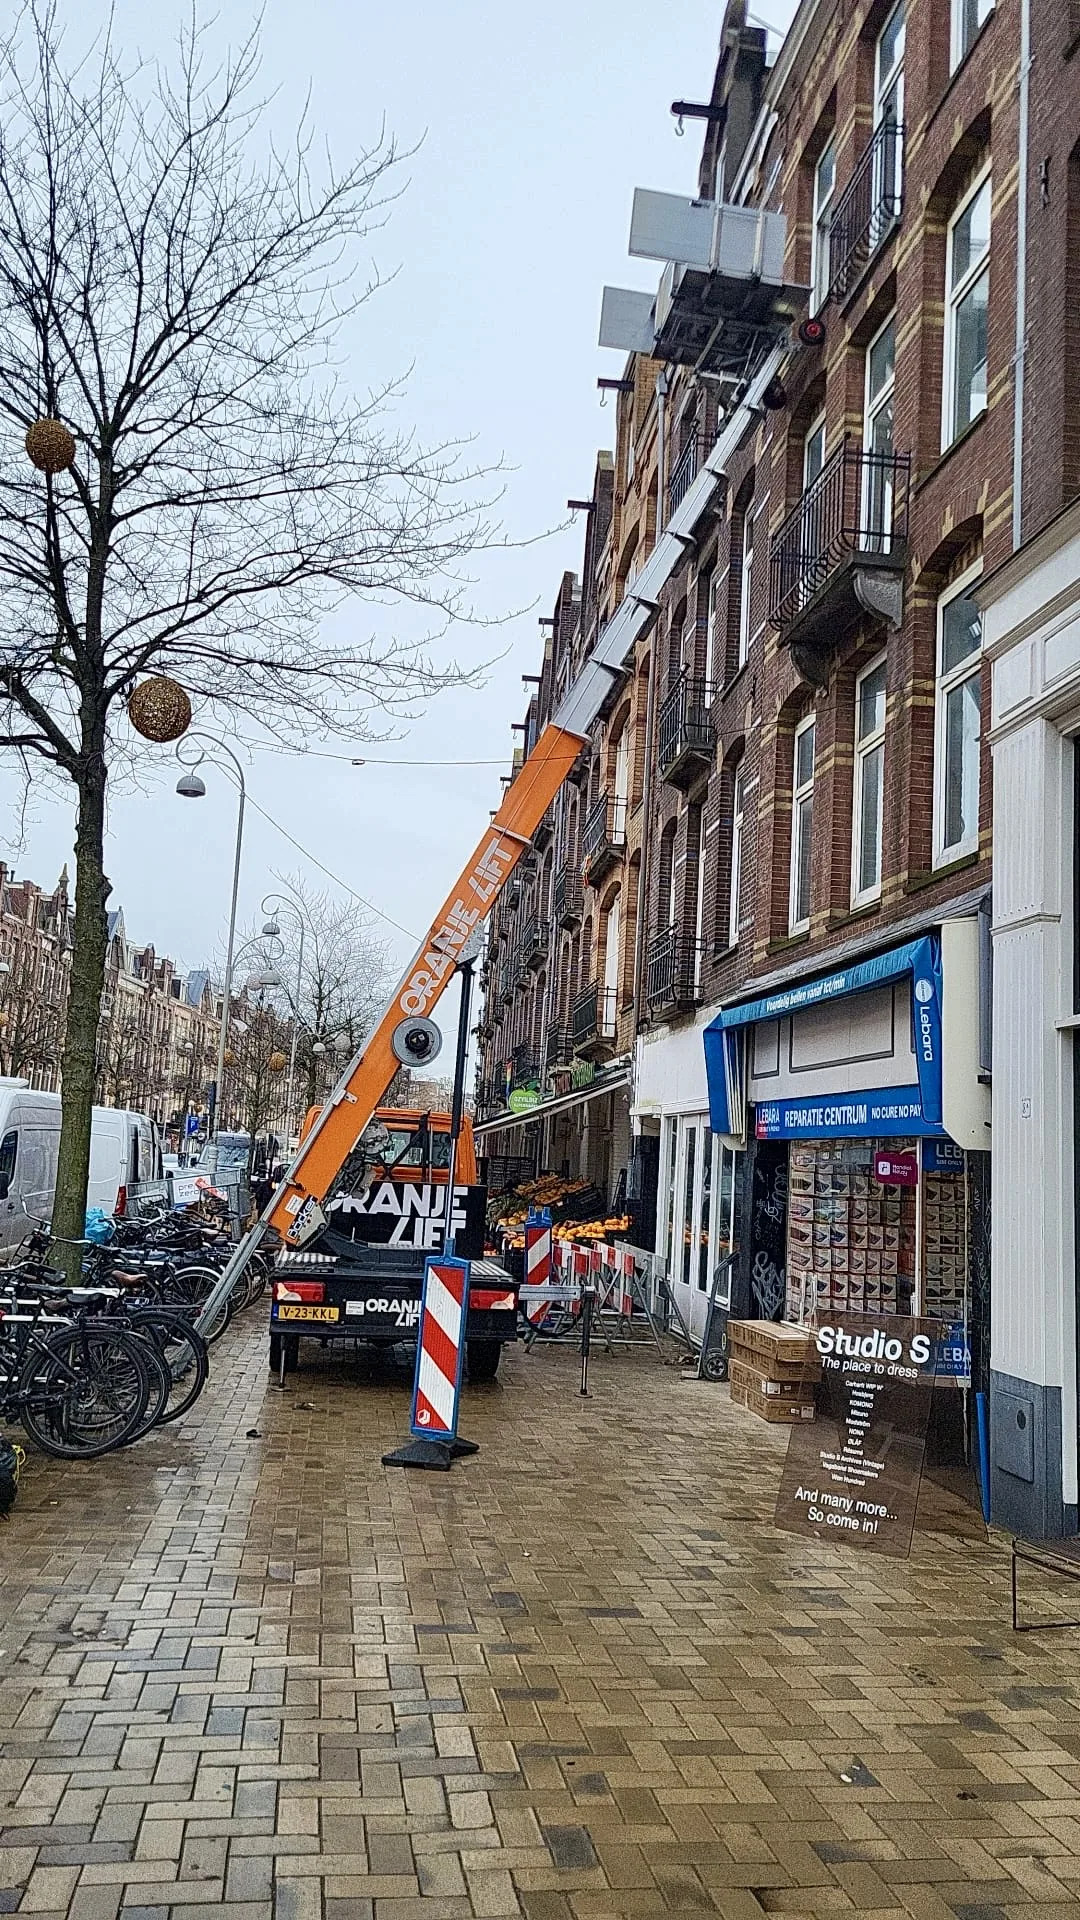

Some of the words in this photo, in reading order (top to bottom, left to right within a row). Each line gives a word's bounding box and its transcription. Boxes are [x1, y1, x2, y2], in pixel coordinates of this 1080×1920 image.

[400, 898, 481, 1016] ORANJE
[468, 837, 513, 903] LIFT
[920, 1006, 933, 1061] Lebara
[758, 1107, 780, 1124] LEBARA
[784, 1109, 824, 1128] REPARATIE
[824, 1104, 867, 1126] CENTRUM
[871, 1107, 880, 1119] NO
[881, 1105, 898, 1119] CURE
[898, 1105, 909, 1118] NO
[909, 1104, 922, 1117] PAY
[178, 1184, 194, 1192] pre
[180, 1189, 199, 1197] zero
[283, 1307, 335, 1320] V-23-KKL
[816, 1326, 903, 1361] Studio
[909, 1334, 931, 1364] S
[821, 1355, 840, 1369] The
[842, 1359, 872, 1373] place
[874, 1363, 885, 1375] to
[887, 1364, 919, 1378] dress
[794, 1485, 819, 1503] And
[820, 1492, 854, 1513] many
[855, 1500, 898, 1520] more...
[807, 1506, 824, 1522] So
[826, 1512, 860, 1530] come
[862, 1517, 879, 1534] in!
